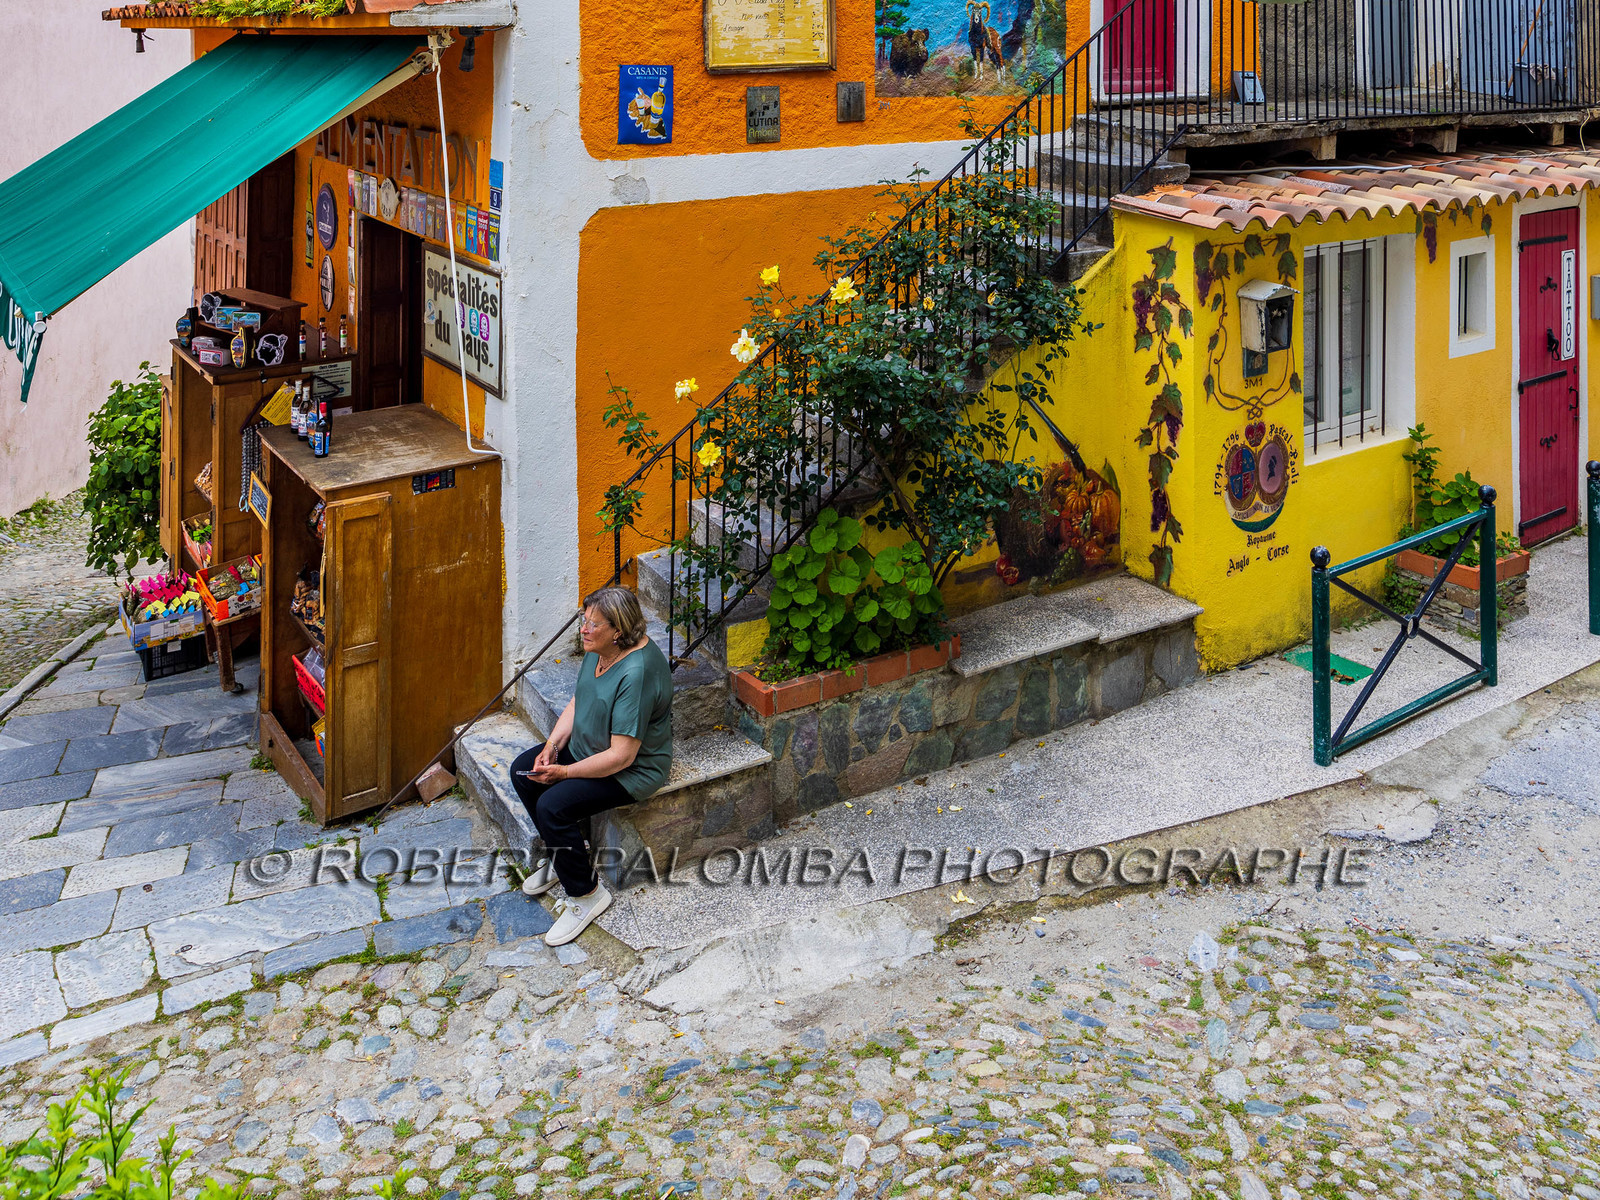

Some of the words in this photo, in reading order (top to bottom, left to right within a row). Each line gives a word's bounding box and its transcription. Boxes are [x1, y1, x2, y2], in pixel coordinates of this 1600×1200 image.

[627, 66, 668, 76] CASANIS
[749, 117, 779, 127] LUTINA
[315, 117, 480, 203] ALIMENTATION
[427, 264, 498, 318] spécialités
[435, 309, 451, 345] du
[1267, 544, 1290, 561] Corse
